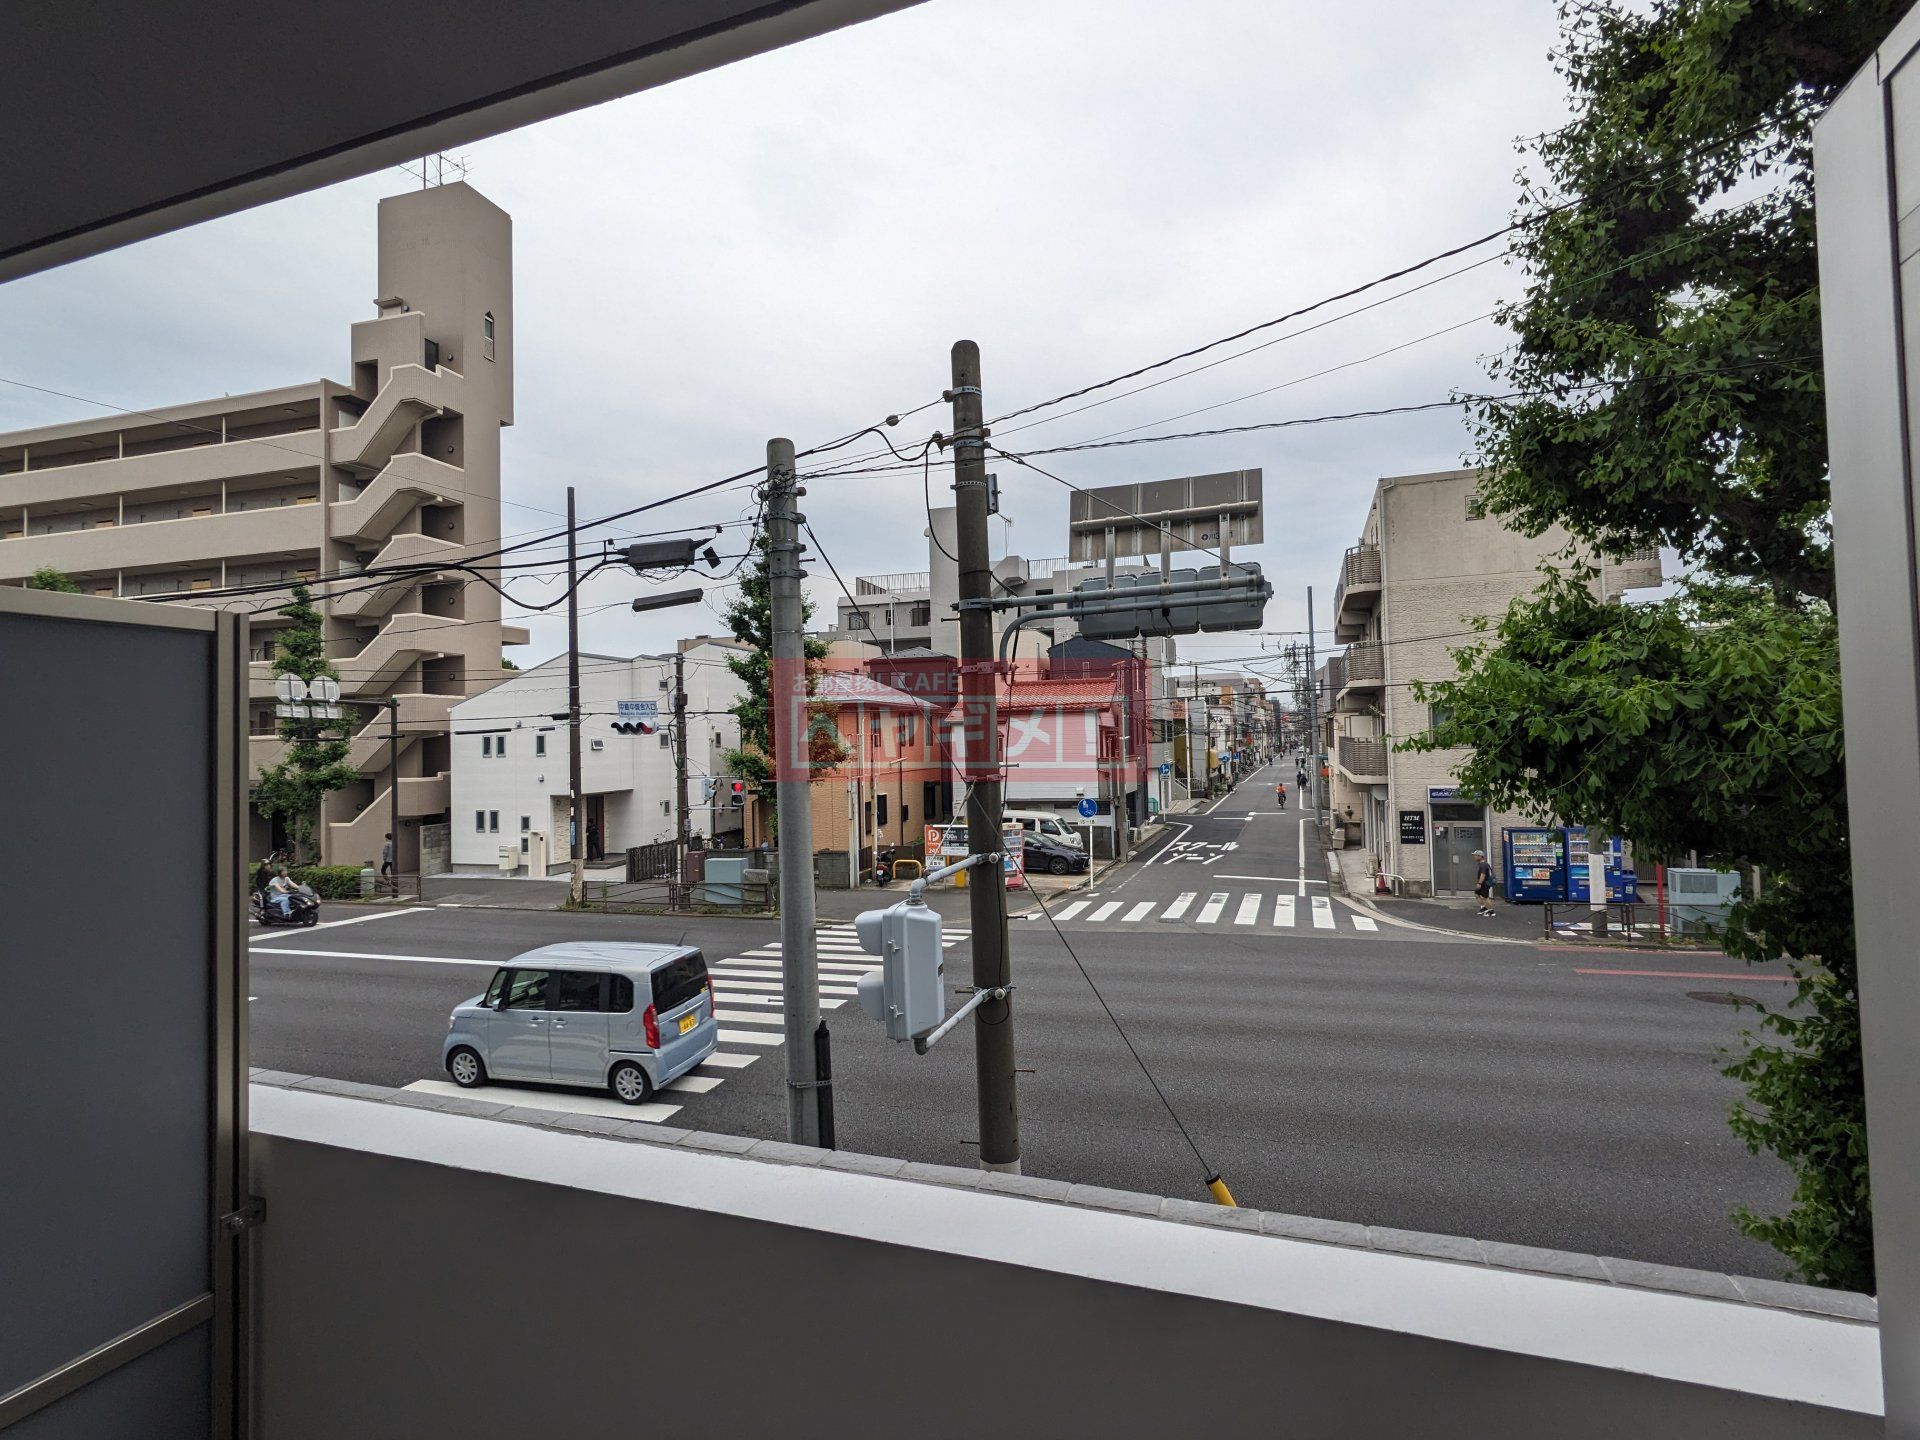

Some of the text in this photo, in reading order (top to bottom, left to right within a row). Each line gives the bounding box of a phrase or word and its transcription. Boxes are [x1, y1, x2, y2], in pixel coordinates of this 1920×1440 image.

[1168, 841, 1240, 851] スクール
[1162, 852, 1226, 865] ゾーン
